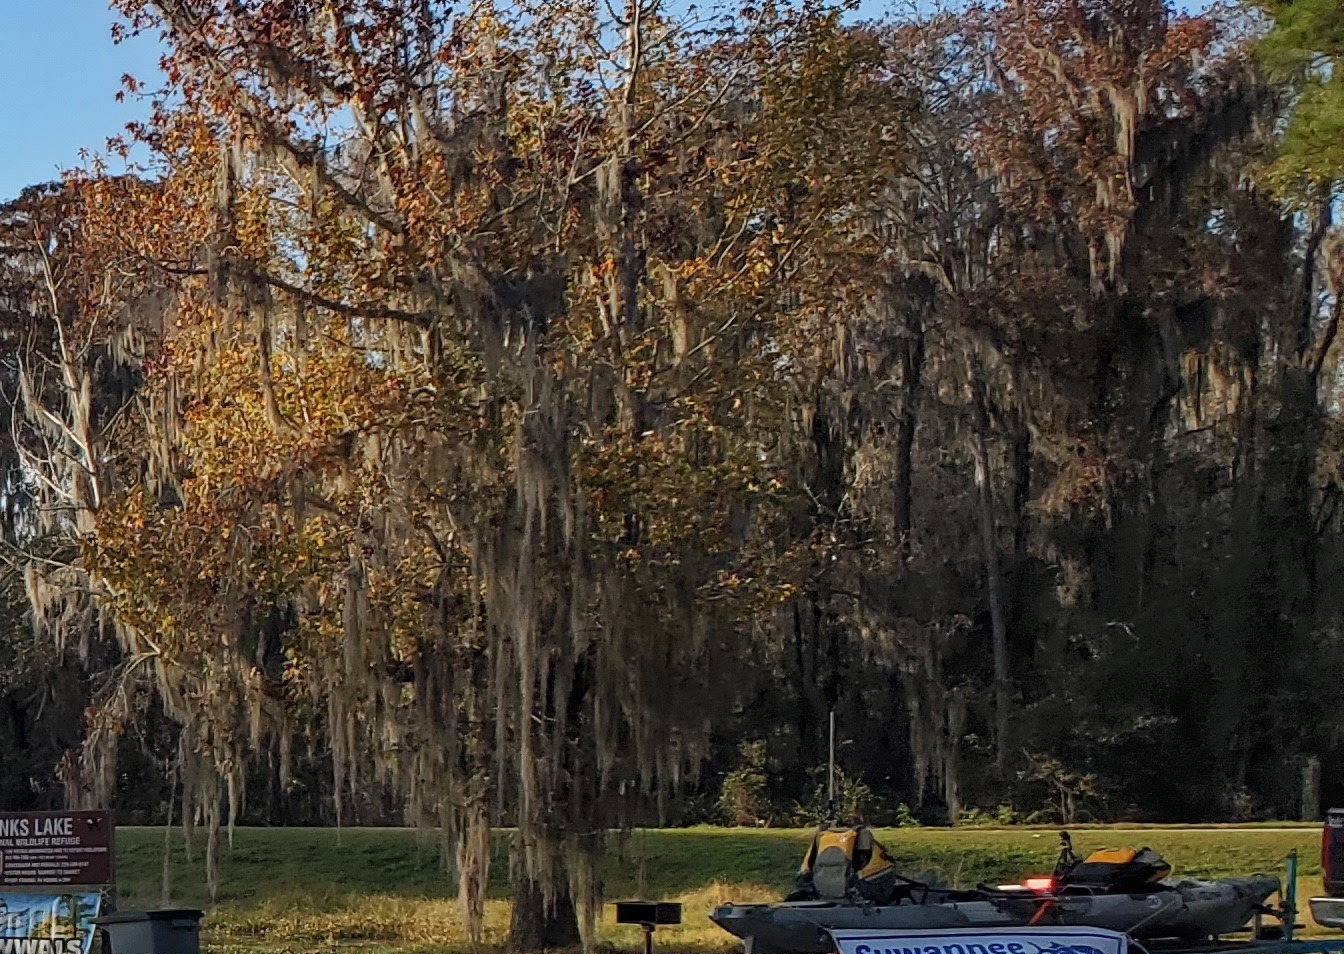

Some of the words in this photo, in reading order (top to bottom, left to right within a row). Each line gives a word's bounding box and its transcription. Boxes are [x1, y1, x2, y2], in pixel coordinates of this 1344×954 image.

[35, 817, 73, 836] LAKE
[16, 837, 49, 846] WILDLIFE
[51, 836, 80, 845] REFUGE
